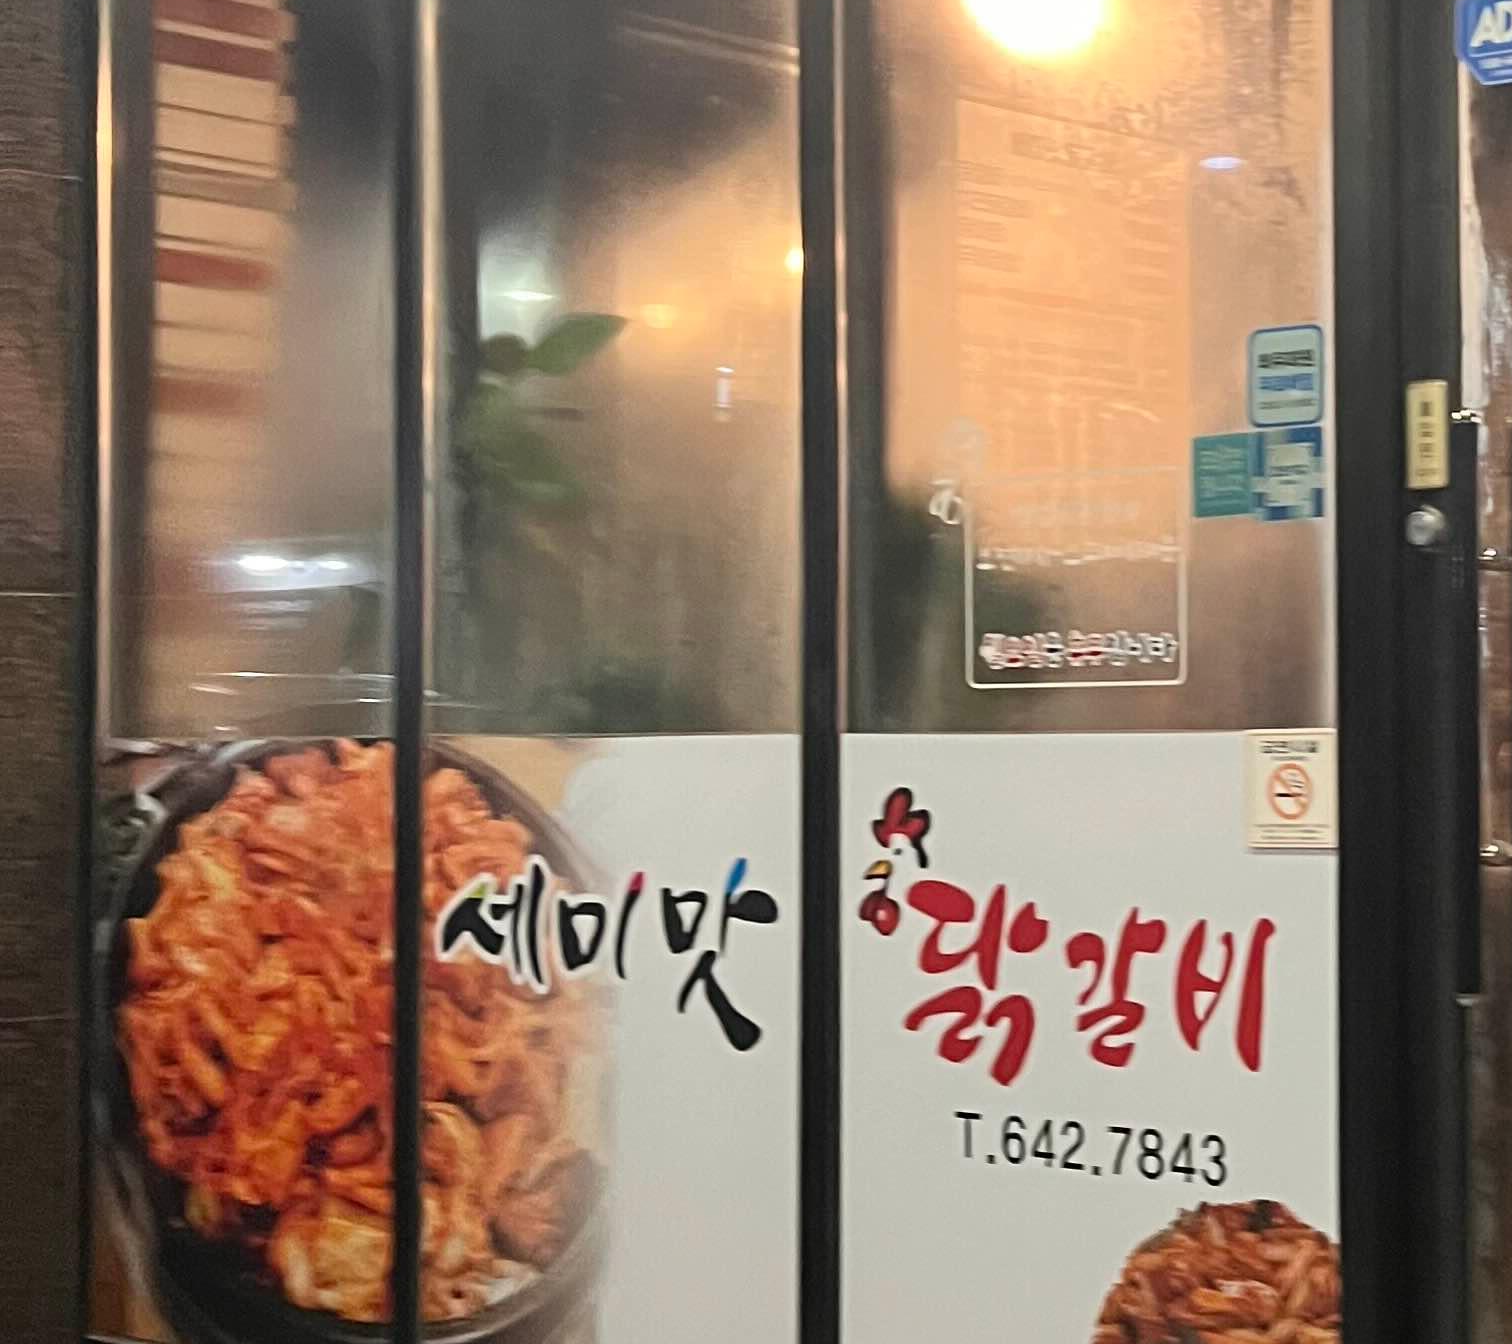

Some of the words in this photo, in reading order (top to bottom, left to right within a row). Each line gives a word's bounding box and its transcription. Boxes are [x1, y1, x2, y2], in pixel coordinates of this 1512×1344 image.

[442, 857, 778, 1052] 세미맛
[905, 879, 1275, 1086] 닭갈비
[954, 1111, 1228, 1187] T.642.7843
